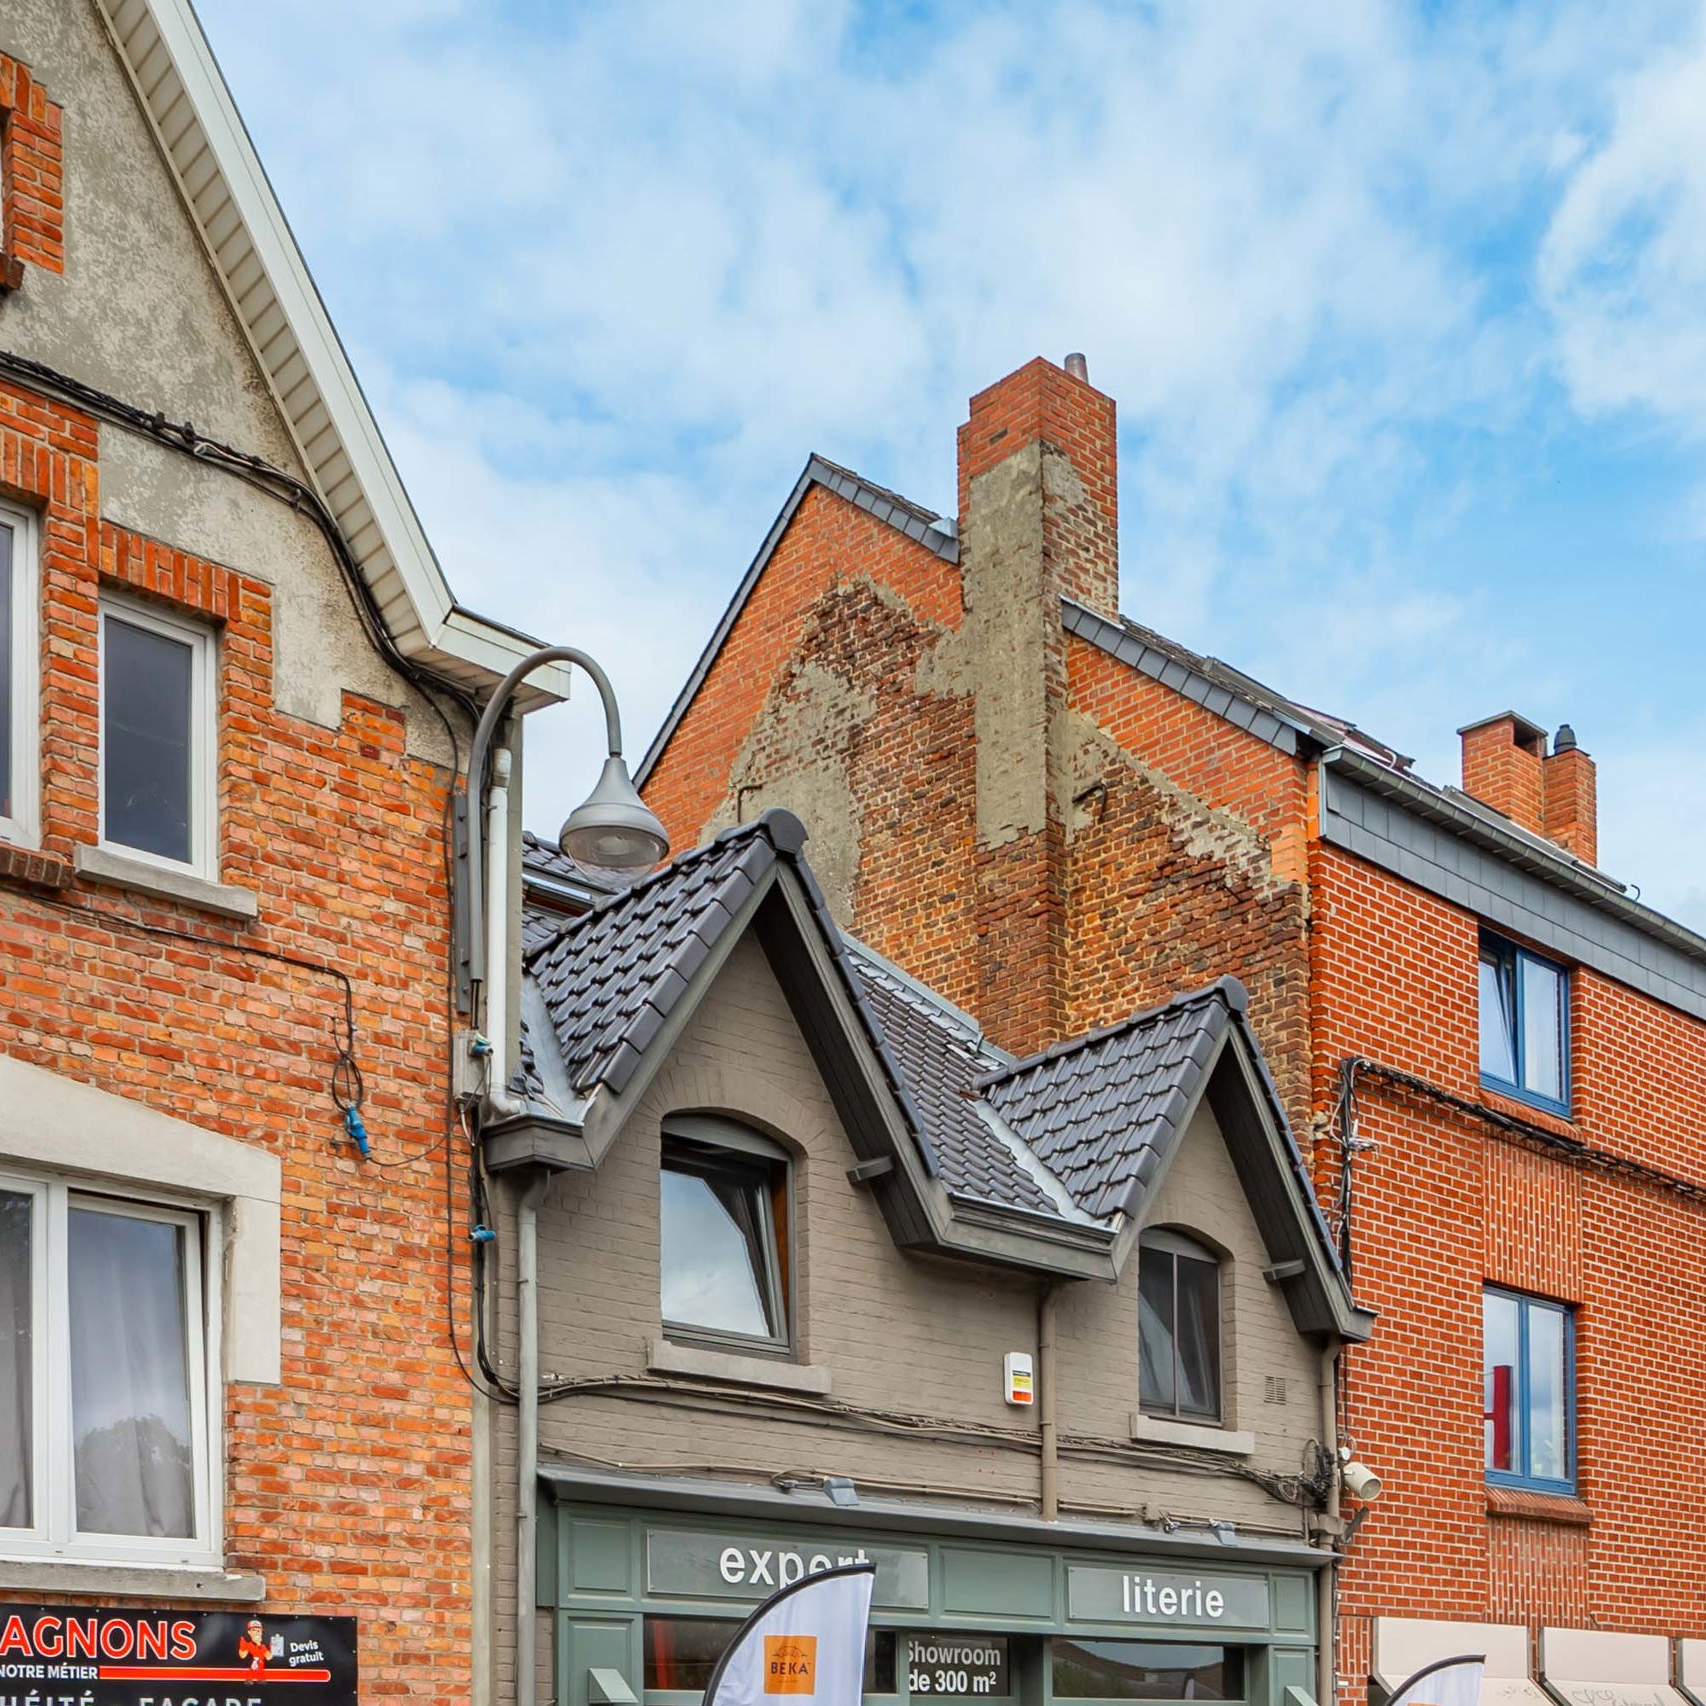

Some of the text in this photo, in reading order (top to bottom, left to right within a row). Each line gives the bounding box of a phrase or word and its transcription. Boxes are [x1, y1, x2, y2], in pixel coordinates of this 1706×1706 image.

[720, 1547, 870, 1590] exp
[1123, 1575, 1224, 1618] literie
[290, 1641, 319, 1654] Devis
[288, 1651, 325, 1667] gratuit
[770, 1661, 809, 1675] BEKA
[47, 1661, 98, 1680] MÉTIER
[909, 1669, 997, 1693] de 300 m²
